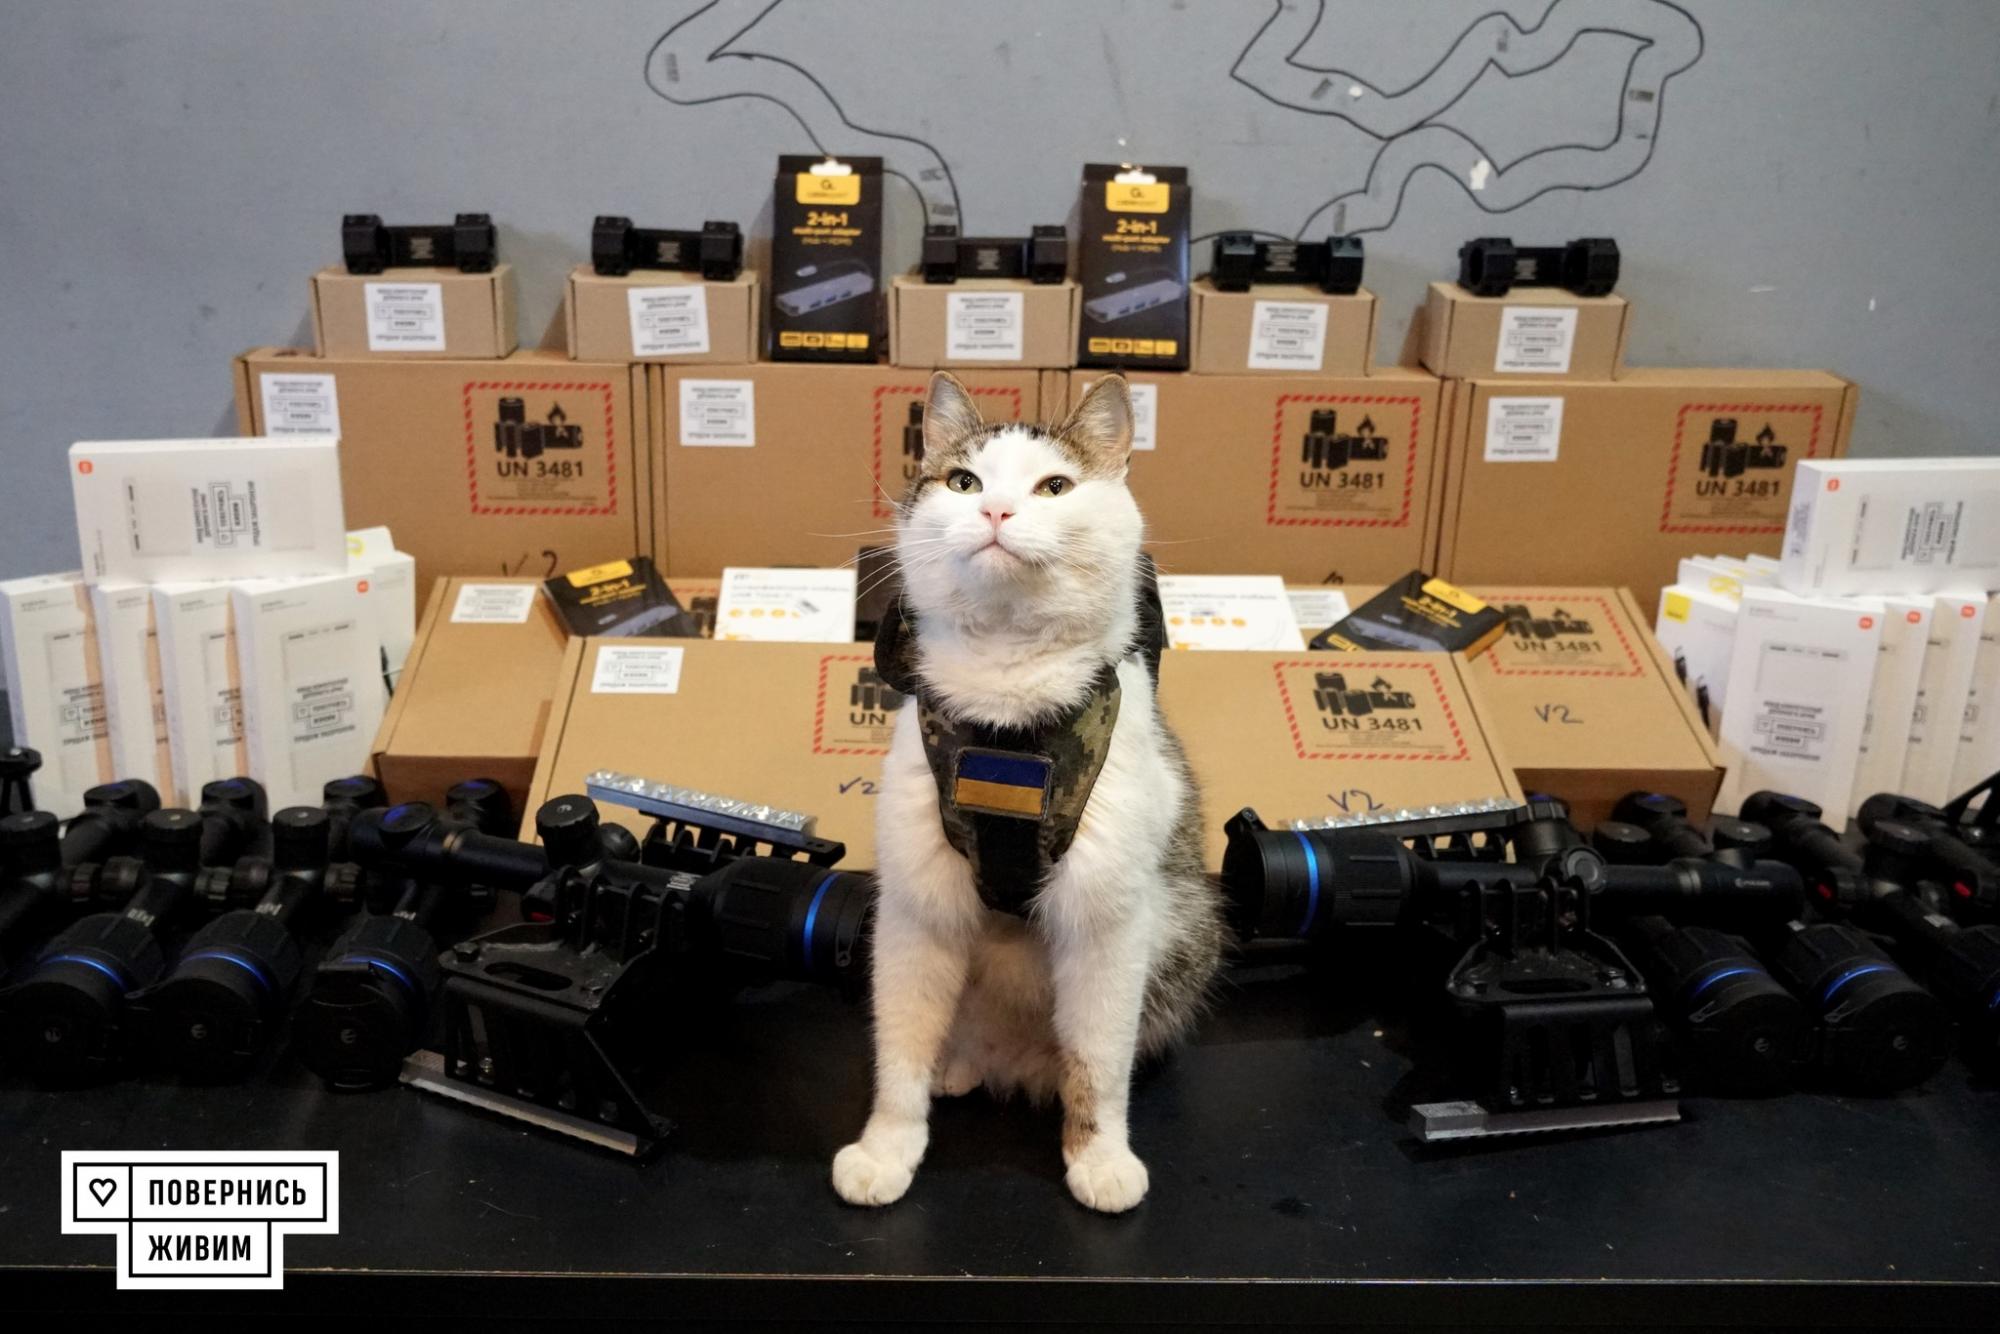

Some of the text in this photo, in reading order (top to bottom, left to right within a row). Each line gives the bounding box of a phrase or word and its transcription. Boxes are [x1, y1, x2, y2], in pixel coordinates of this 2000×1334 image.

[497, 461, 583, 477] UN 3481
[1300, 472, 1385, 489] UN 3481
[1695, 480, 1780, 496] UN 3481
[1513, 641, 1603, 653] UN 3481
[850, 712, 887, 726] UN
[1321, 717, 1423, 731] UN 3481
